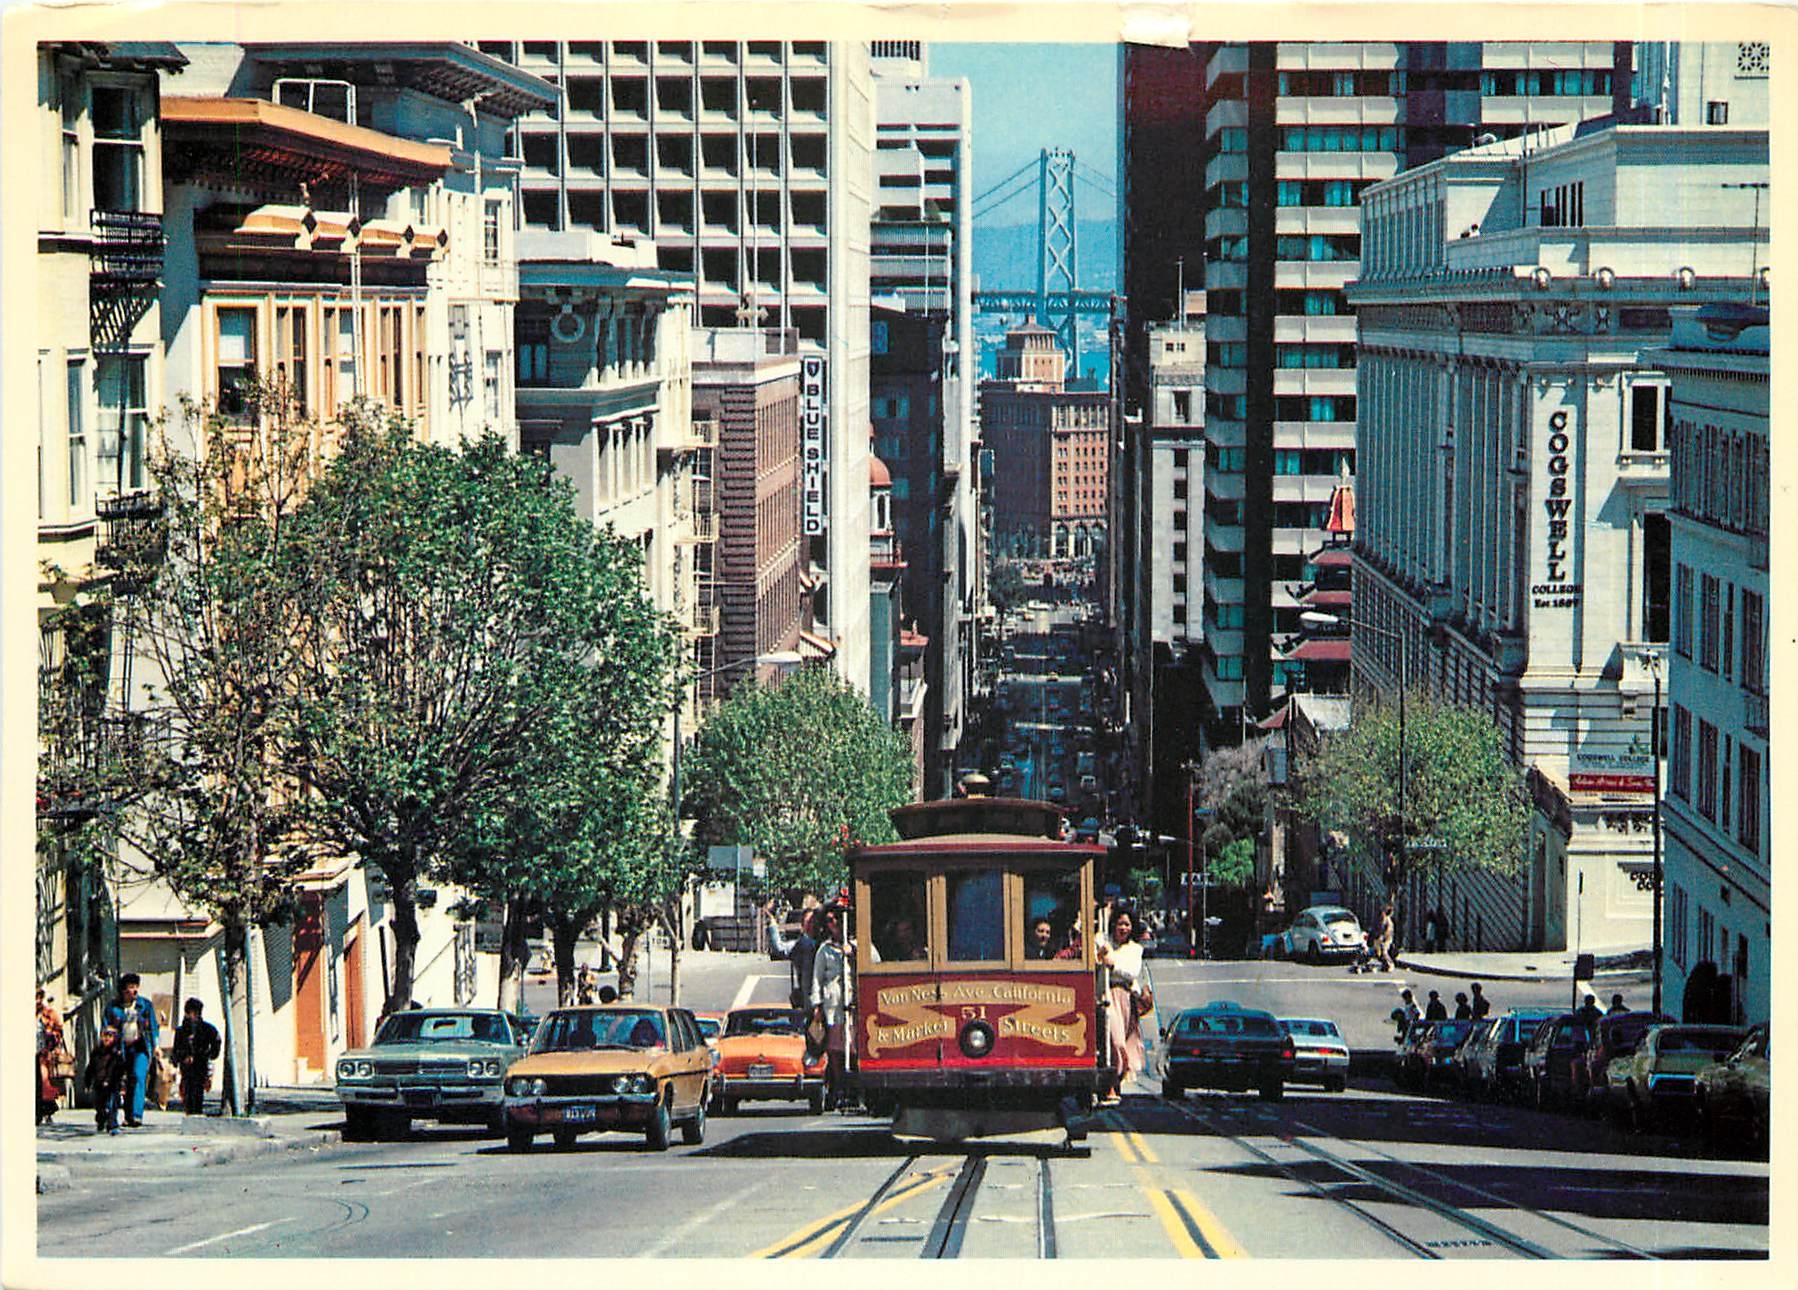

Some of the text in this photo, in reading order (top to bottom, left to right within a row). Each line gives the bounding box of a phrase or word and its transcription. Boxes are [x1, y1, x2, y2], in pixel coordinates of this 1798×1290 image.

[806, 383, 820, 532] BLUE SHIELD
[1544, 410, 1572, 582] COGSWELL
[1532, 584, 1584, 595] COLLEGE
[880, 991, 909, 1005] Van
[910, 984, 948, 1001] Ness
[992, 985, 1072, 1006] California
[961, 1006, 987, 1020] 51
[877, 1018, 1072, 1043] & Market Streets
